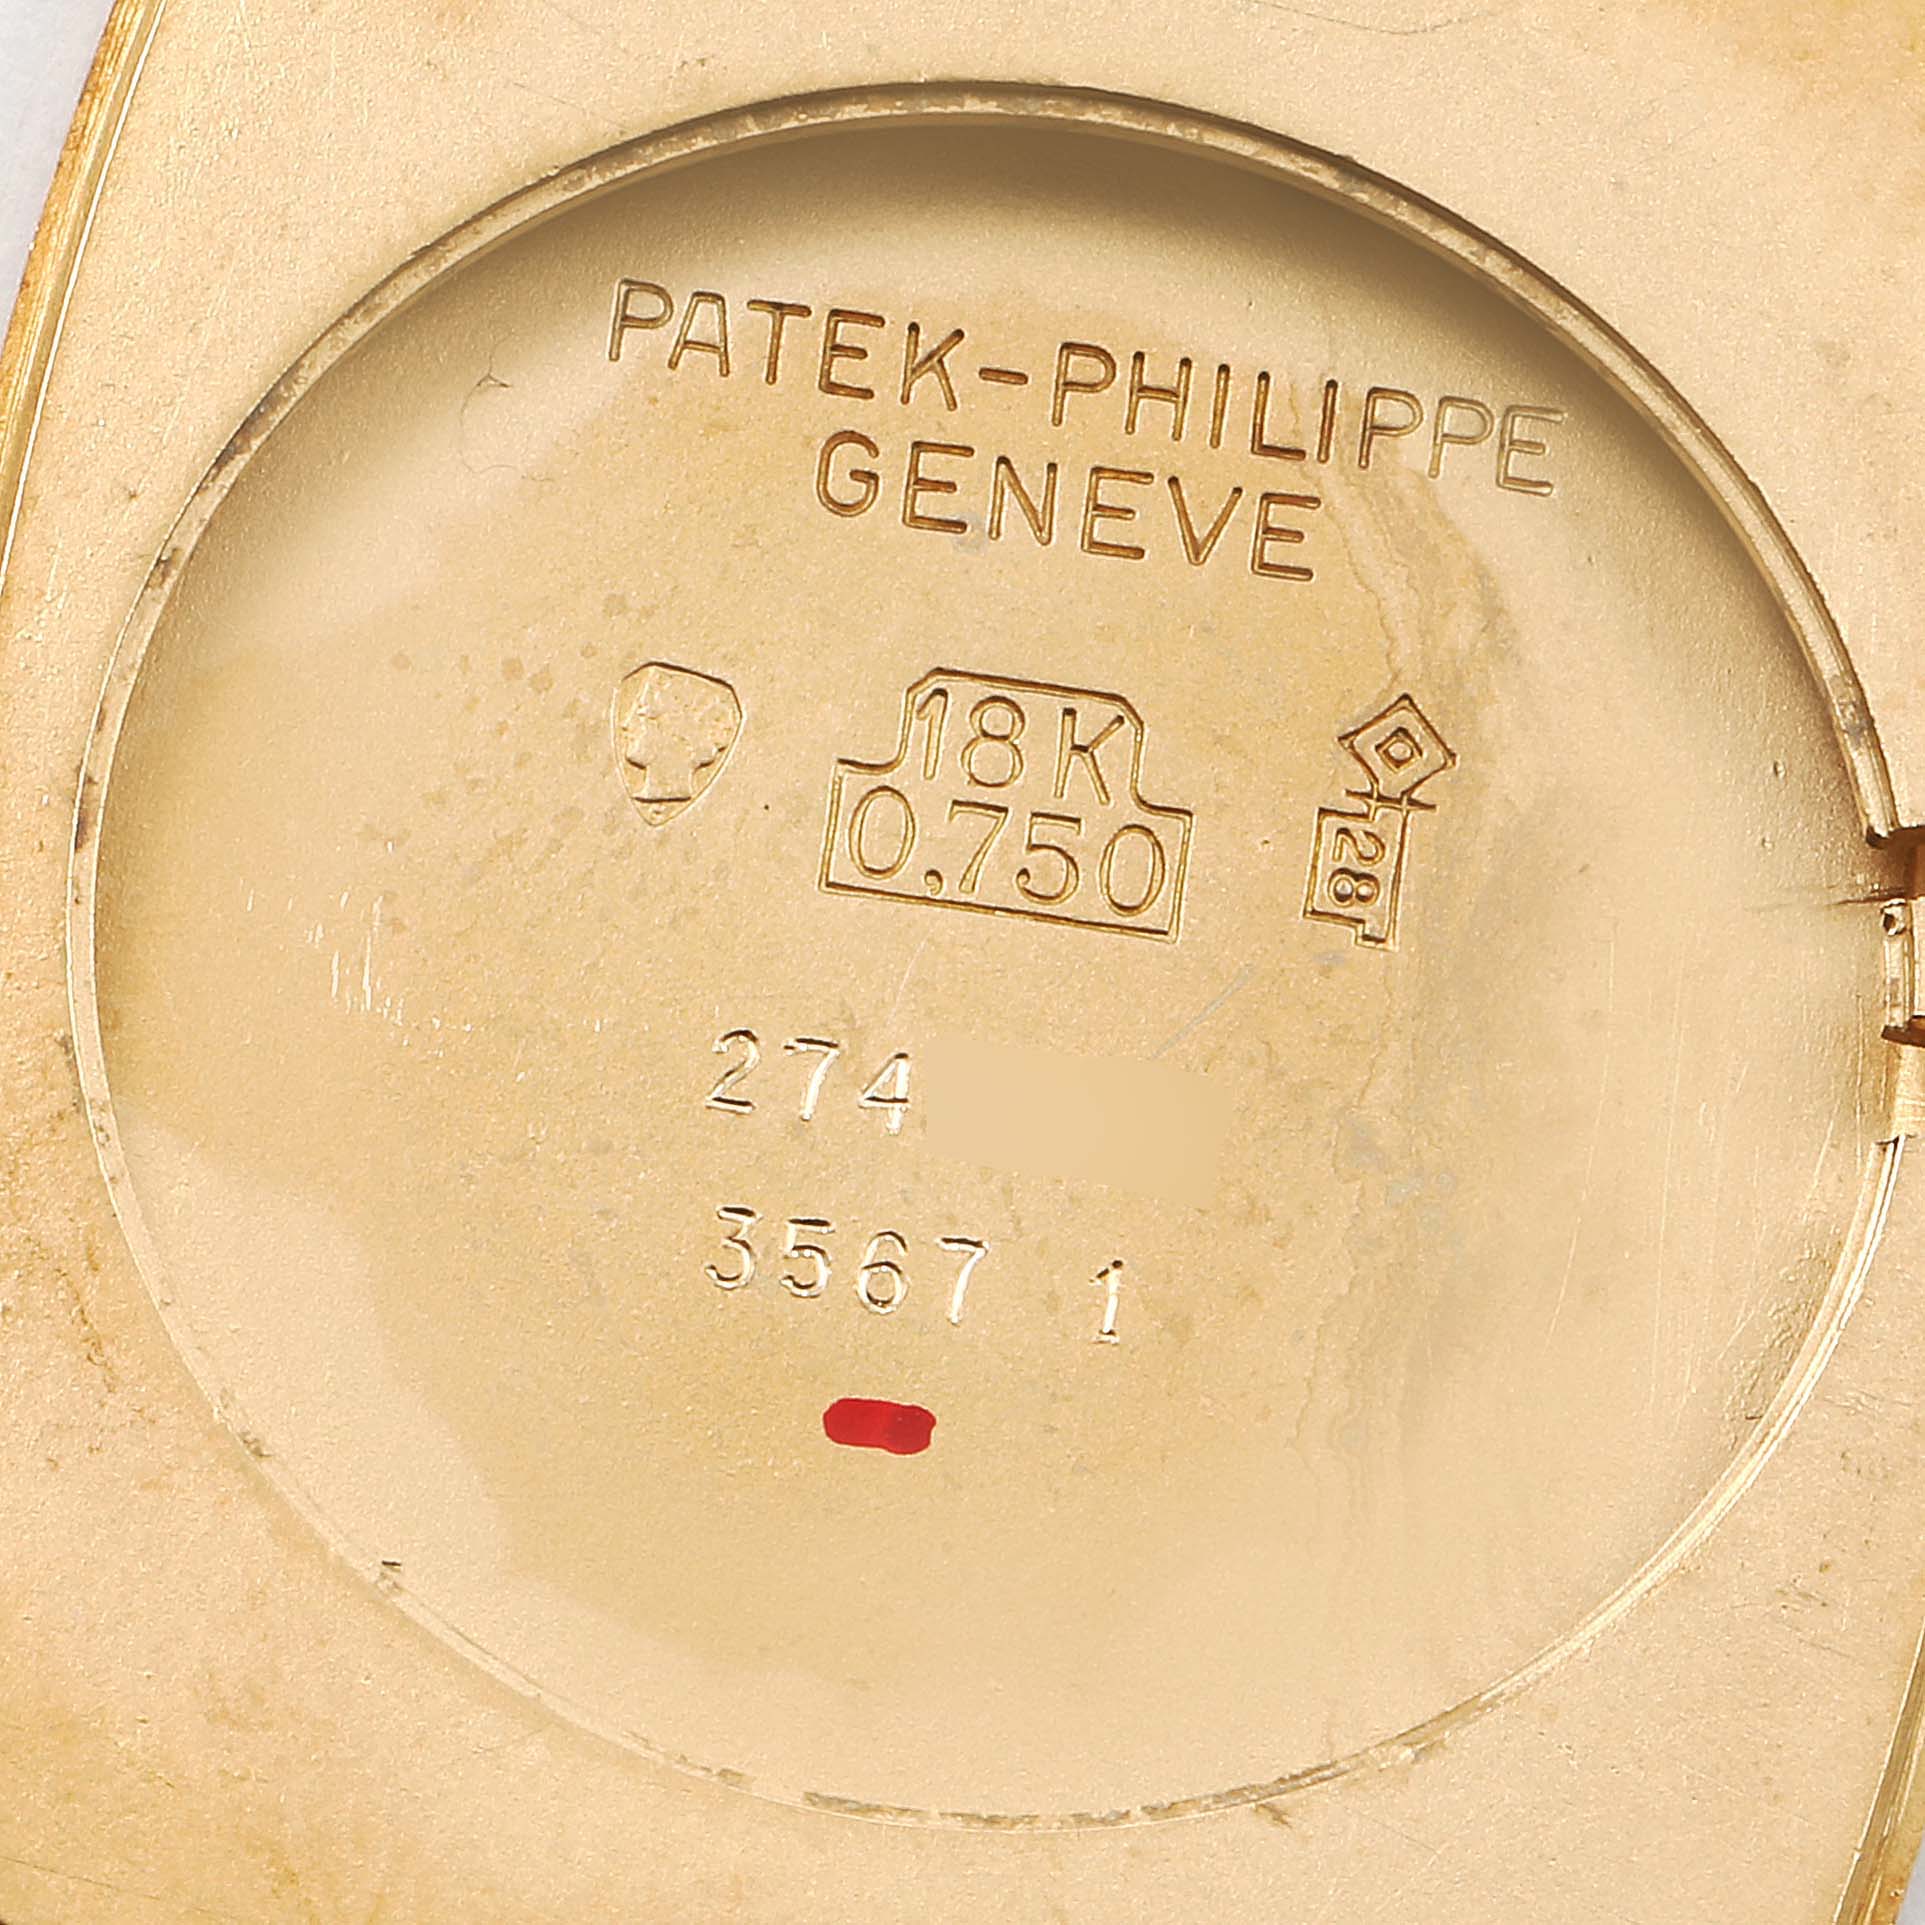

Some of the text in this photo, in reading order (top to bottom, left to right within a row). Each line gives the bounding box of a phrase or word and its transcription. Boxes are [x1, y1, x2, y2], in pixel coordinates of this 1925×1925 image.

[816, 429, 1322, 581] GENEVE
[705, 1204, 1124, 1345] 3567 1
